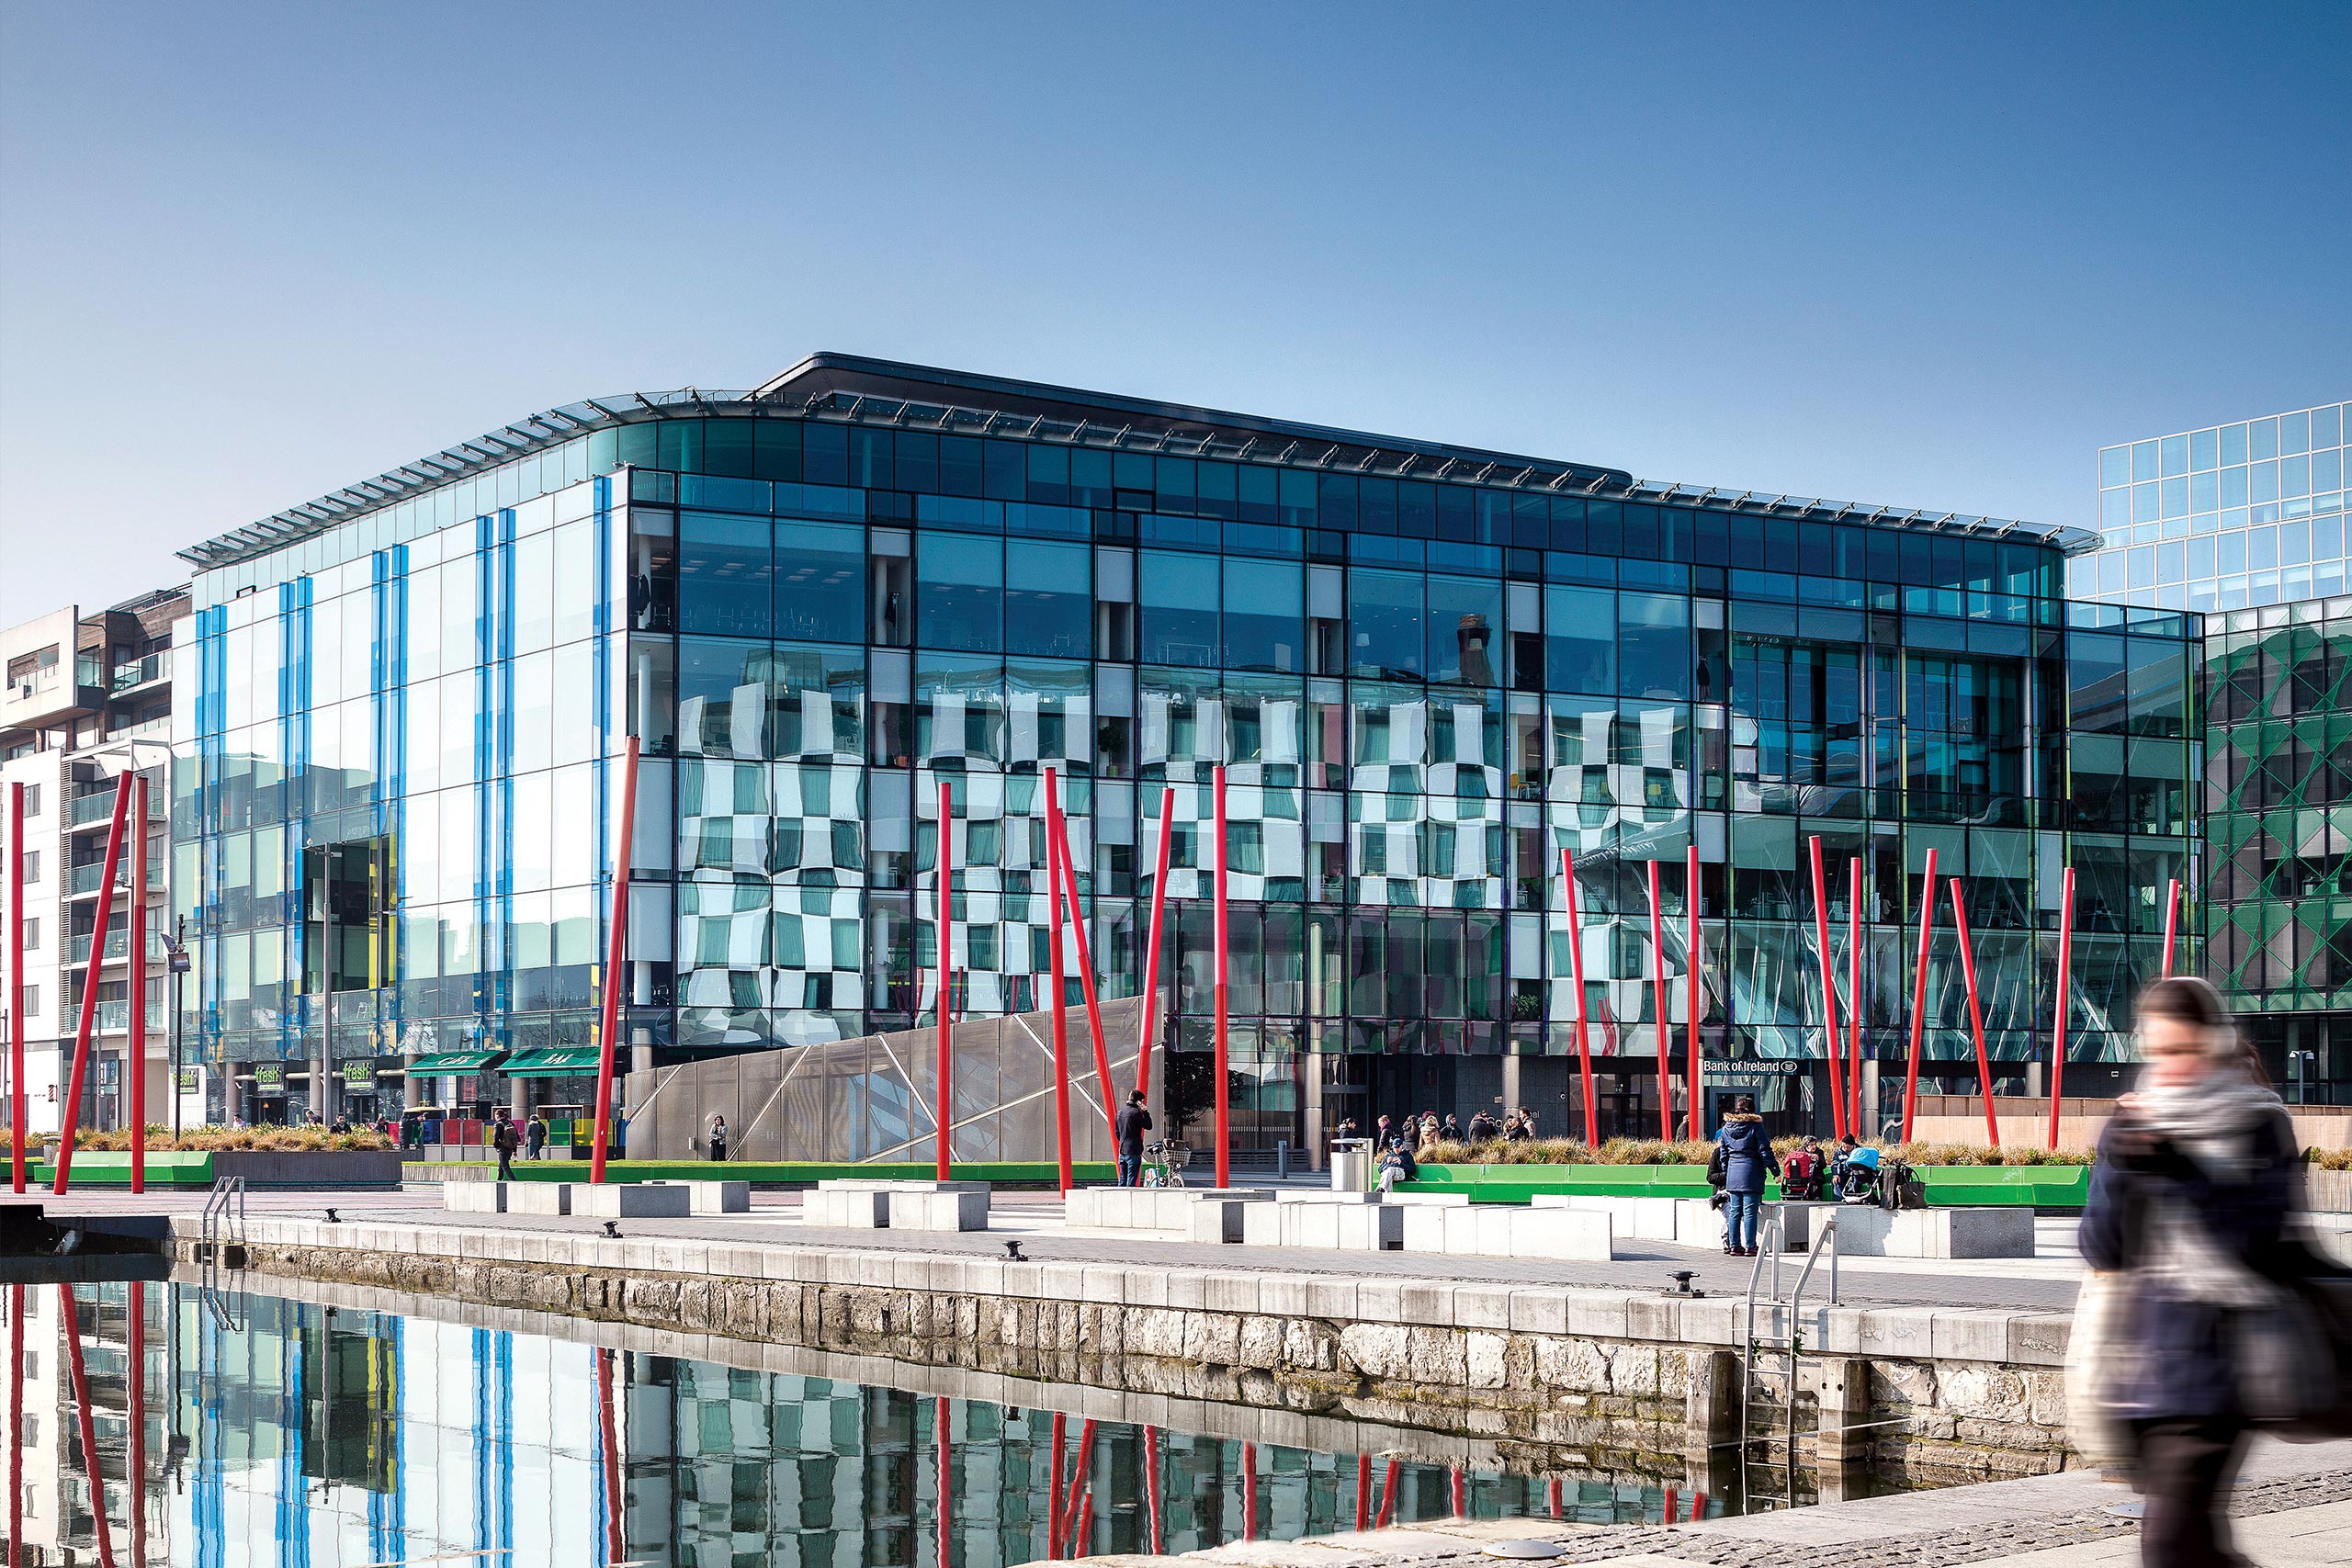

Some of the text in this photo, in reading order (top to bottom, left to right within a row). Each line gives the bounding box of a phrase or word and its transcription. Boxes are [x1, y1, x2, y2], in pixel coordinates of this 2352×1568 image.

[255, 1066, 279, 1083] fresh
[344, 1062, 369, 1080] fresh
[1703, 1060, 1780, 1072] Bank of Ireland
[172, 1069, 193, 1086] fesh
